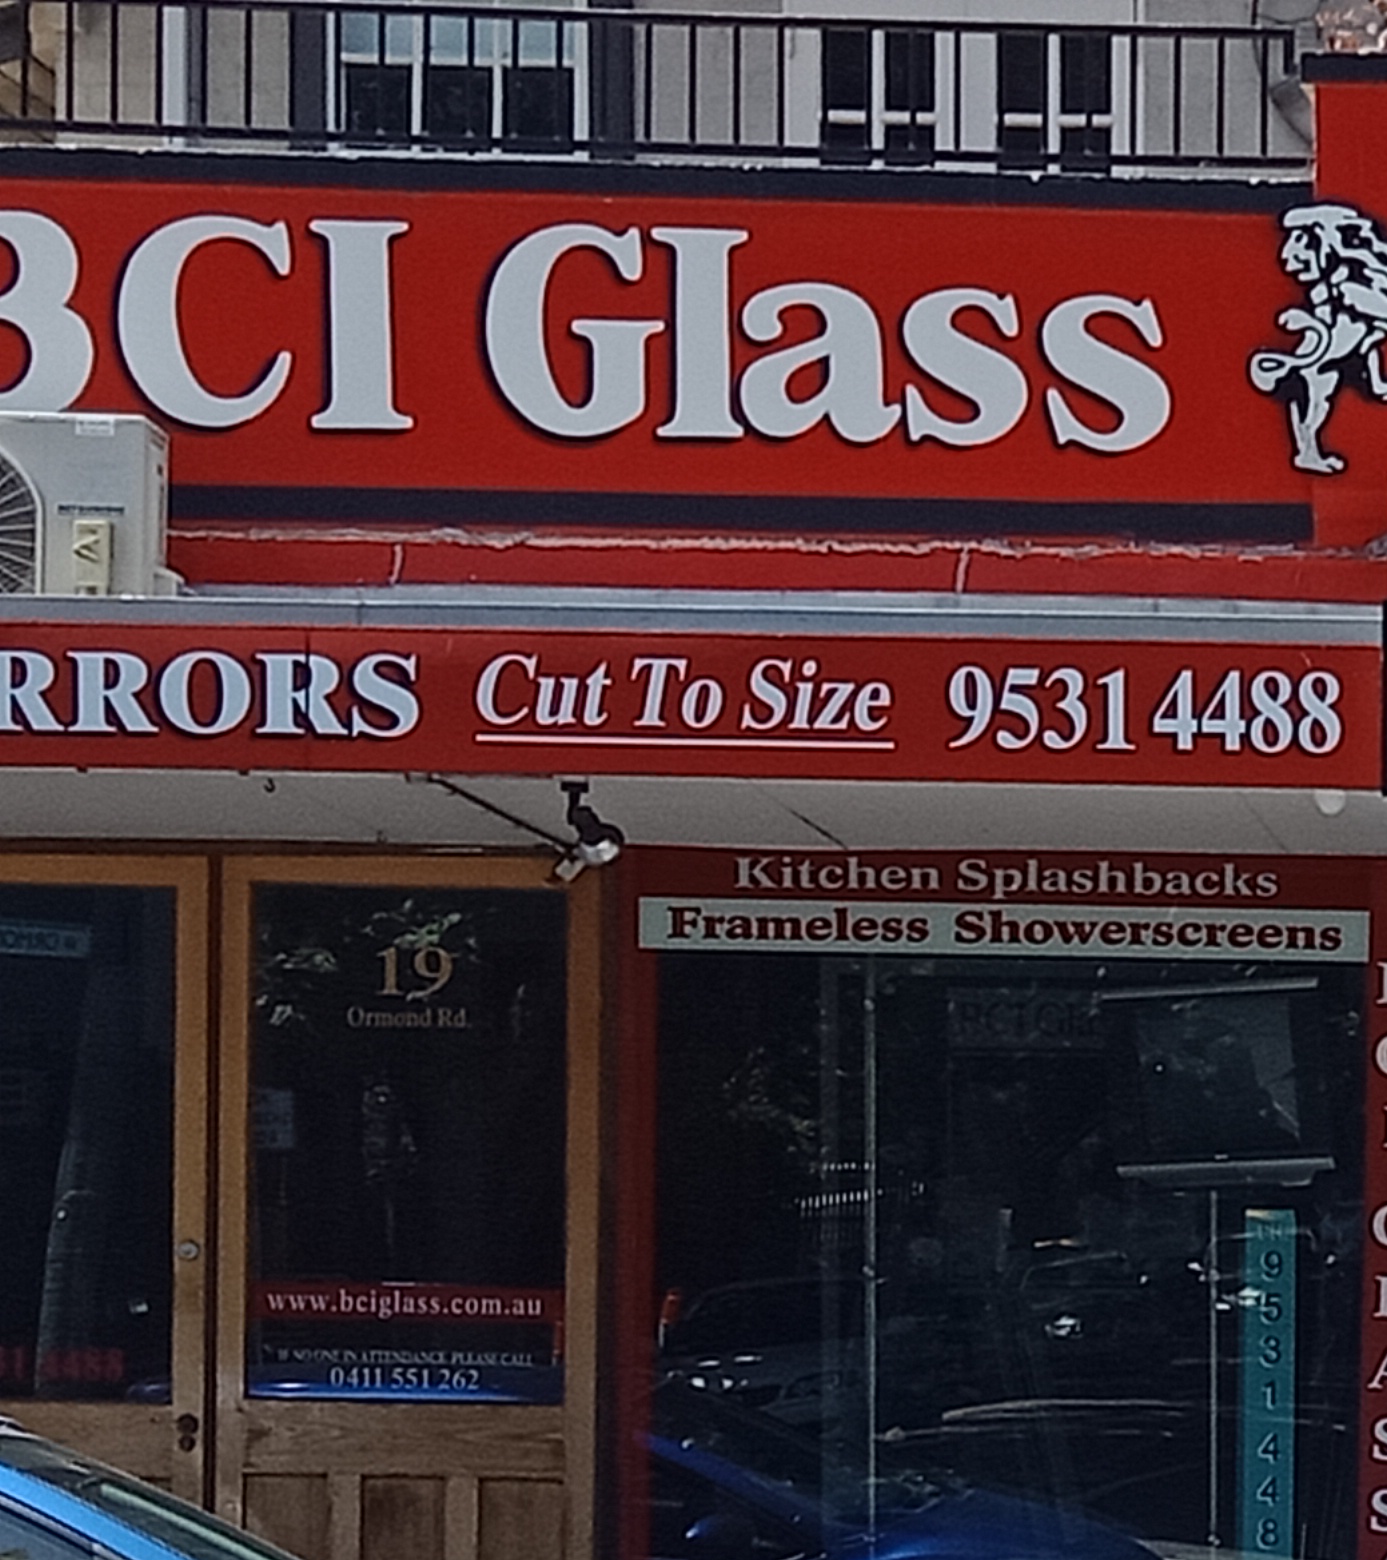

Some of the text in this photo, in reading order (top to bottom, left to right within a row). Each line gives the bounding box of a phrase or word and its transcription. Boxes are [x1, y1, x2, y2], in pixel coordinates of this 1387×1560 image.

[0, 210, 1171, 453] BCI Glass
[475, 654, 1342, 753] Cut To Size 9531 4488
[733, 857, 1280, 905] Kitchen Splashbacks
[666, 906, 1343, 951] Frameless Showerscreens
[376, 944, 456, 997] 19
[347, 1005, 472, 1029] Ormond Rd.
[266, 1288, 543, 1319] www.bciglass.com.au
[330, 1366, 480, 1390] 0411 551 262
